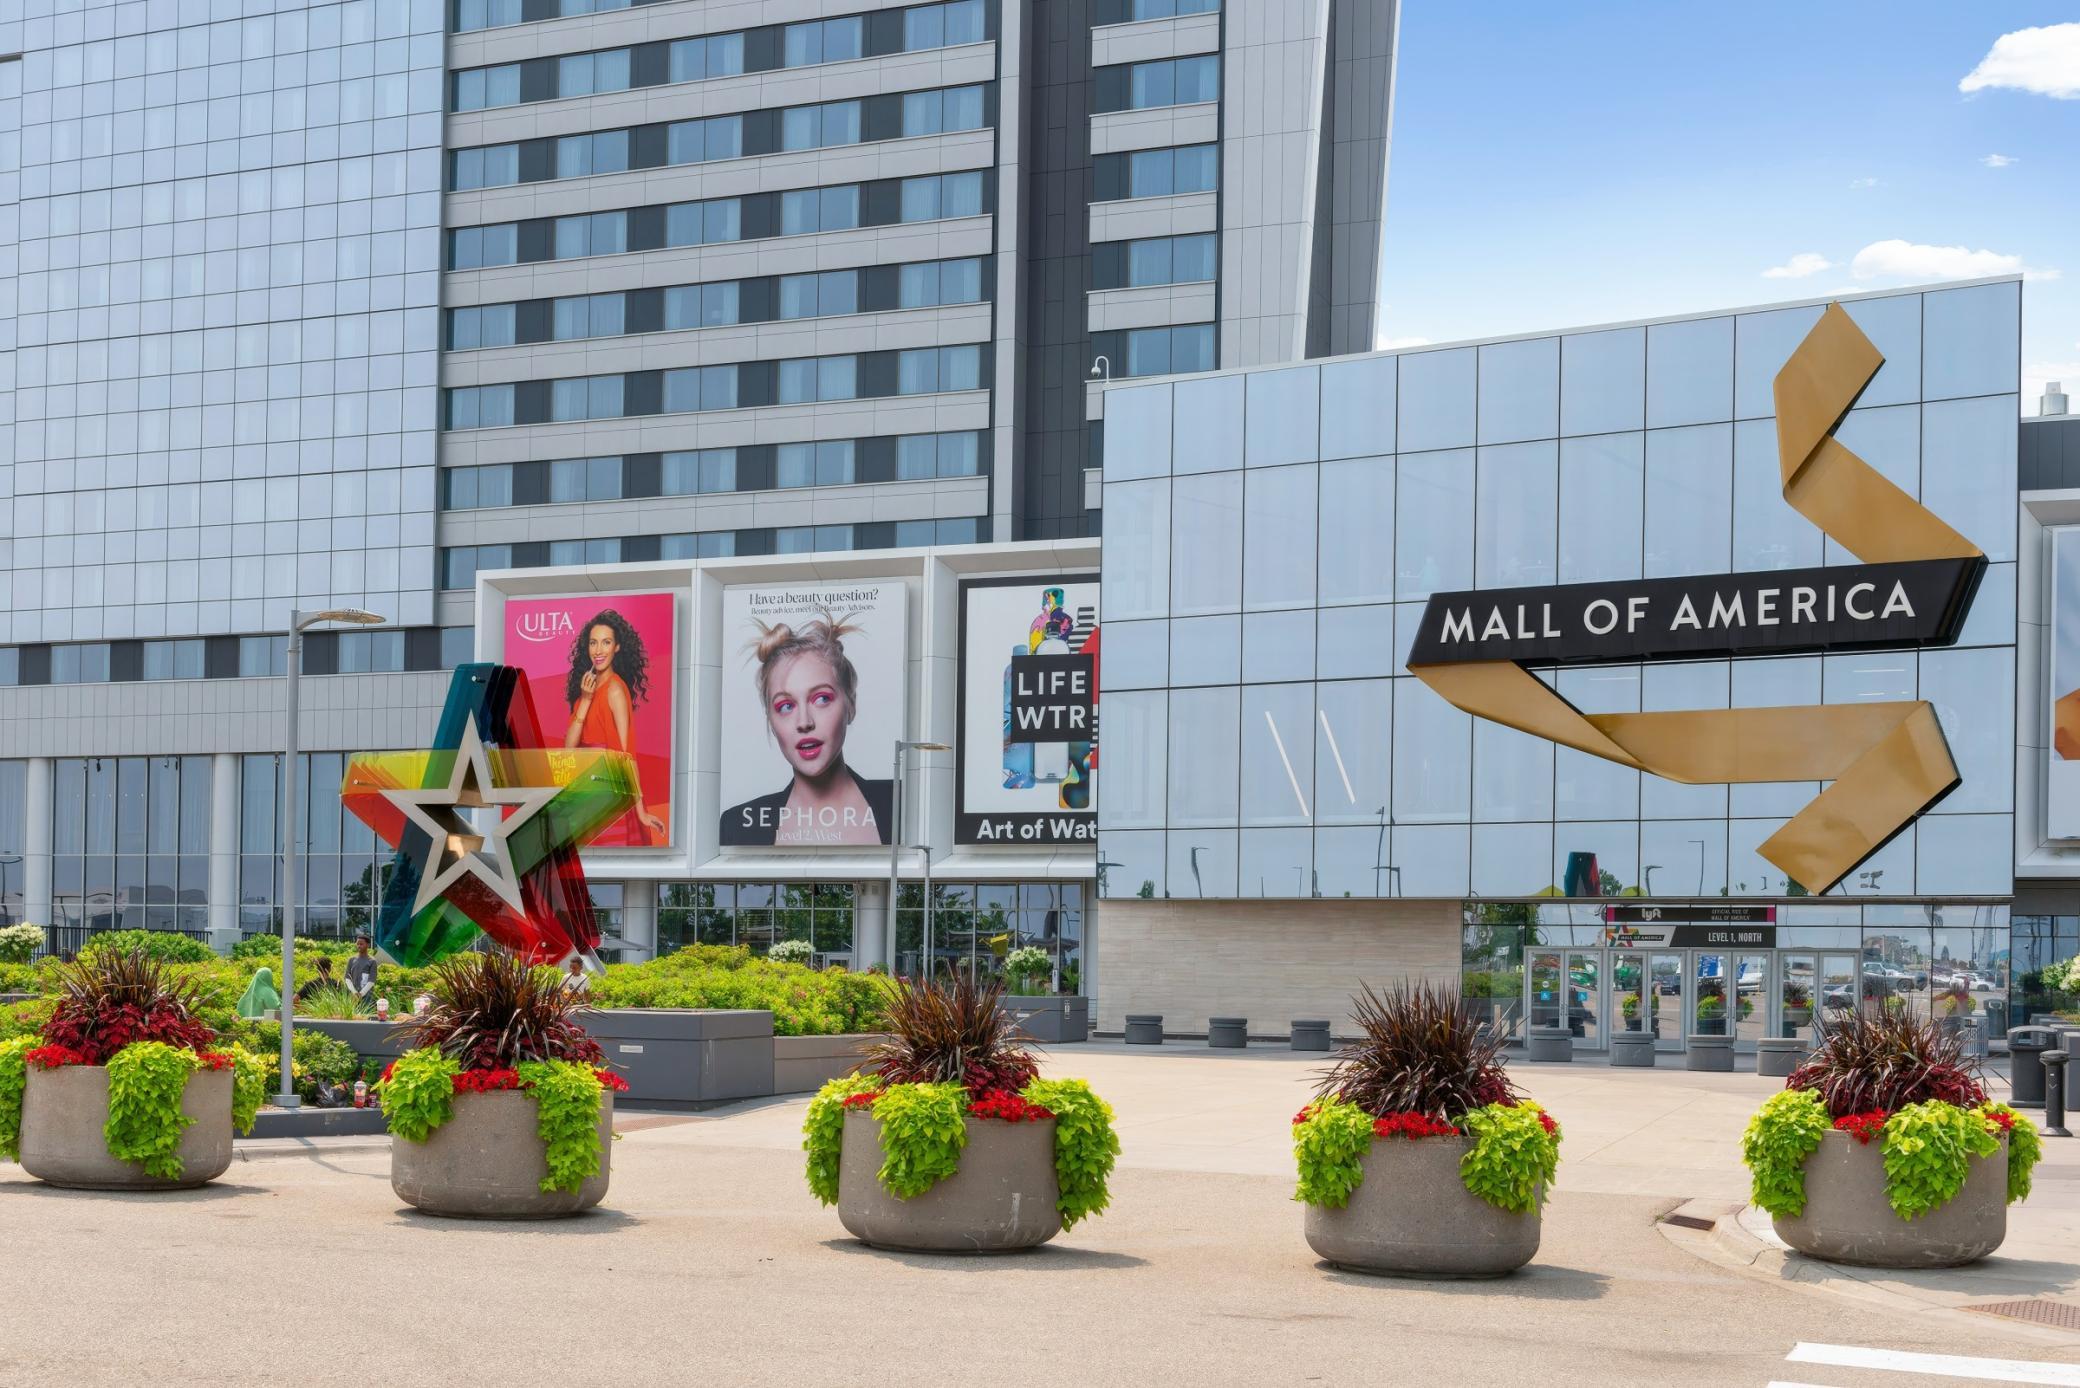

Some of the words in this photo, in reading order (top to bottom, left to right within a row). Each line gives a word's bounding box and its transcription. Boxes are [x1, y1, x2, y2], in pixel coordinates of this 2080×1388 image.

[749, 593, 776, 605] Have
[777, 596, 784, 604] a
[785, 592, 821, 604] beauty
[824, 587, 879, 605] question?
[751, 607, 772, 615] Beauty
[795, 605, 810, 613] meet
[1439, 604, 1561, 644] MALL
[1583, 596, 1650, 635] OF
[1670, 578, 1917, 631] AMERICA
[524, 611, 573, 632] ULTA
[1018, 671, 1086, 696] LIFE
[1016, 705, 1086, 730] WTR
[742, 806, 877, 828] SEPHORA
[776, 829, 802, 841] Level
[814, 829, 842, 841] West
[977, 819, 1014, 840] Art
[1020, 818, 1044, 840] of
[1050, 818, 1097, 840] Wat
[1708, 932, 1728, 943] LEVEL
[1731, 932, 1736, 943] 1,
[1738, 932, 1762, 943] NORTH
